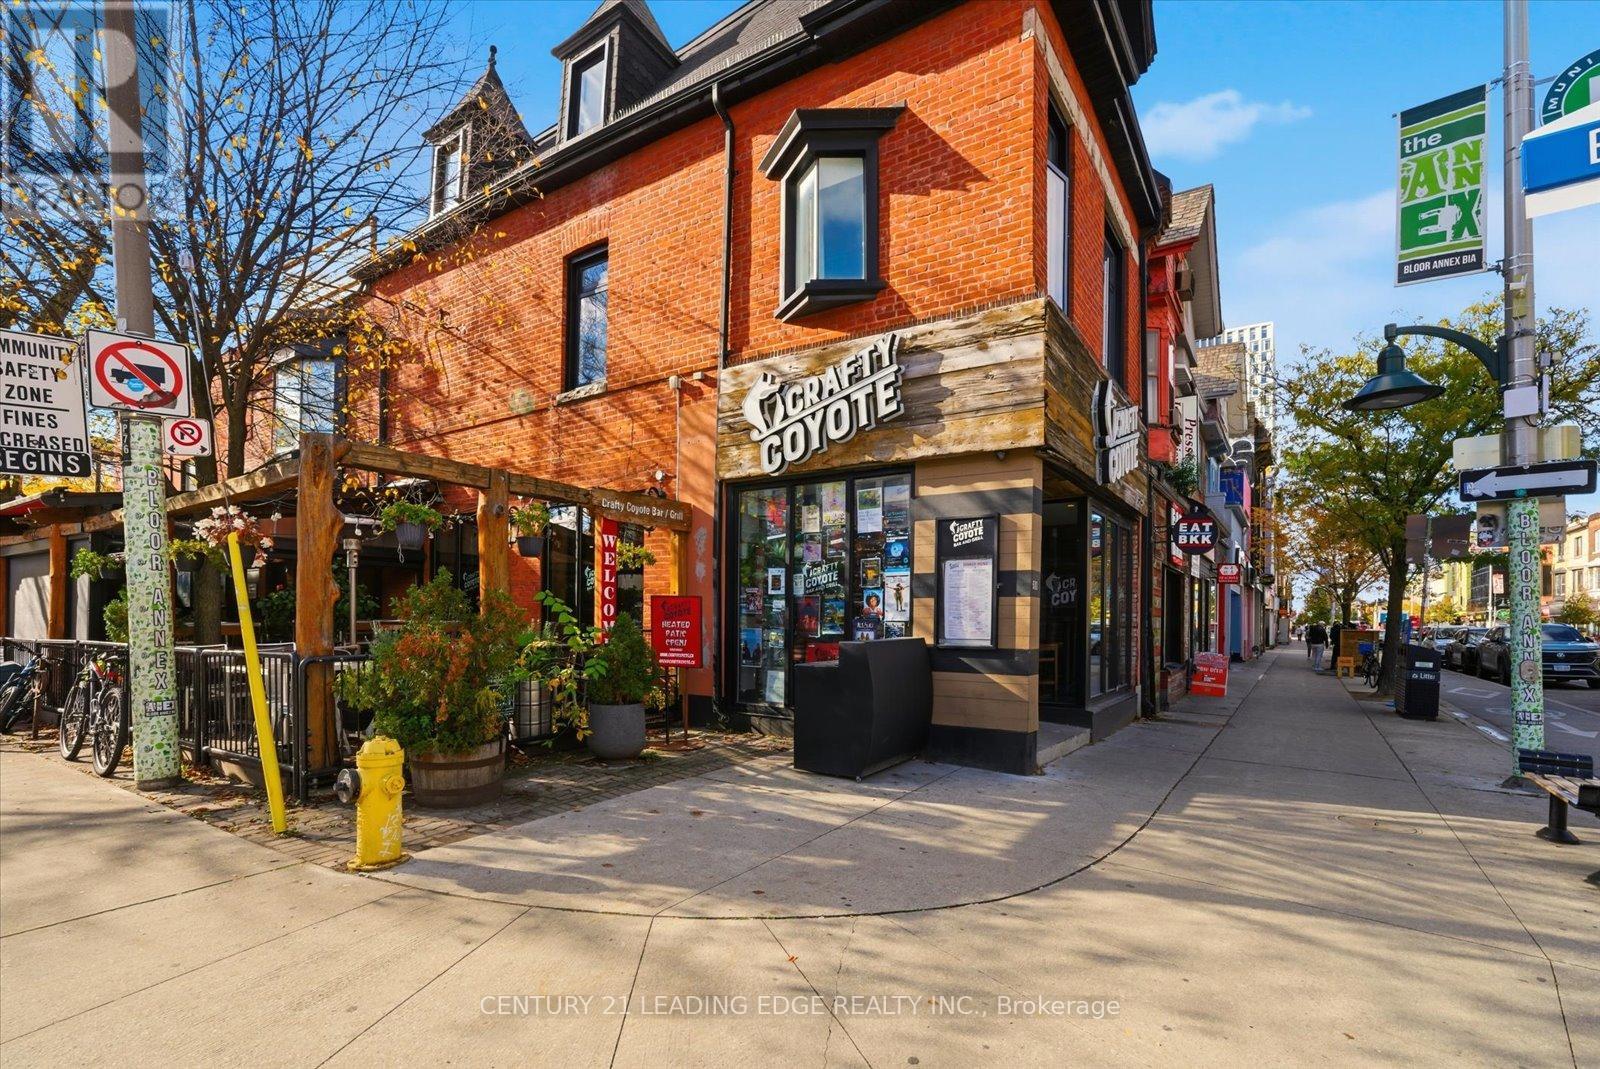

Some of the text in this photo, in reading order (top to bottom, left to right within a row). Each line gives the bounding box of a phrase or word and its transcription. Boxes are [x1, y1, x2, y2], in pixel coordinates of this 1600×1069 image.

[1404, 132, 1442, 154] the
[1404, 253, 1477, 275] BLOOR ANNEX BIA
[785, 333, 899, 418] CRAFTY
[5, 384, 54, 404] ZONE
[4, 409, 58, 429] FINES
[761, 372, 904, 476] COYOTE
[0, 450, 80, 474] EGINS
[602, 498, 625, 512] Crafty
[626, 502, 651, 515] Coyote
[651, 506, 663, 518] Bar
[669, 510, 684, 520] Grill
[953, 527, 984, 542] COYOTE
[960, 519, 984, 532] CRAFTY
[1178, 522, 1213, 532] EAT
[1178, 535, 1212, 545] BKK
[805, 571, 839, 589] COYOTE
[661, 621, 690, 629] HEATED
